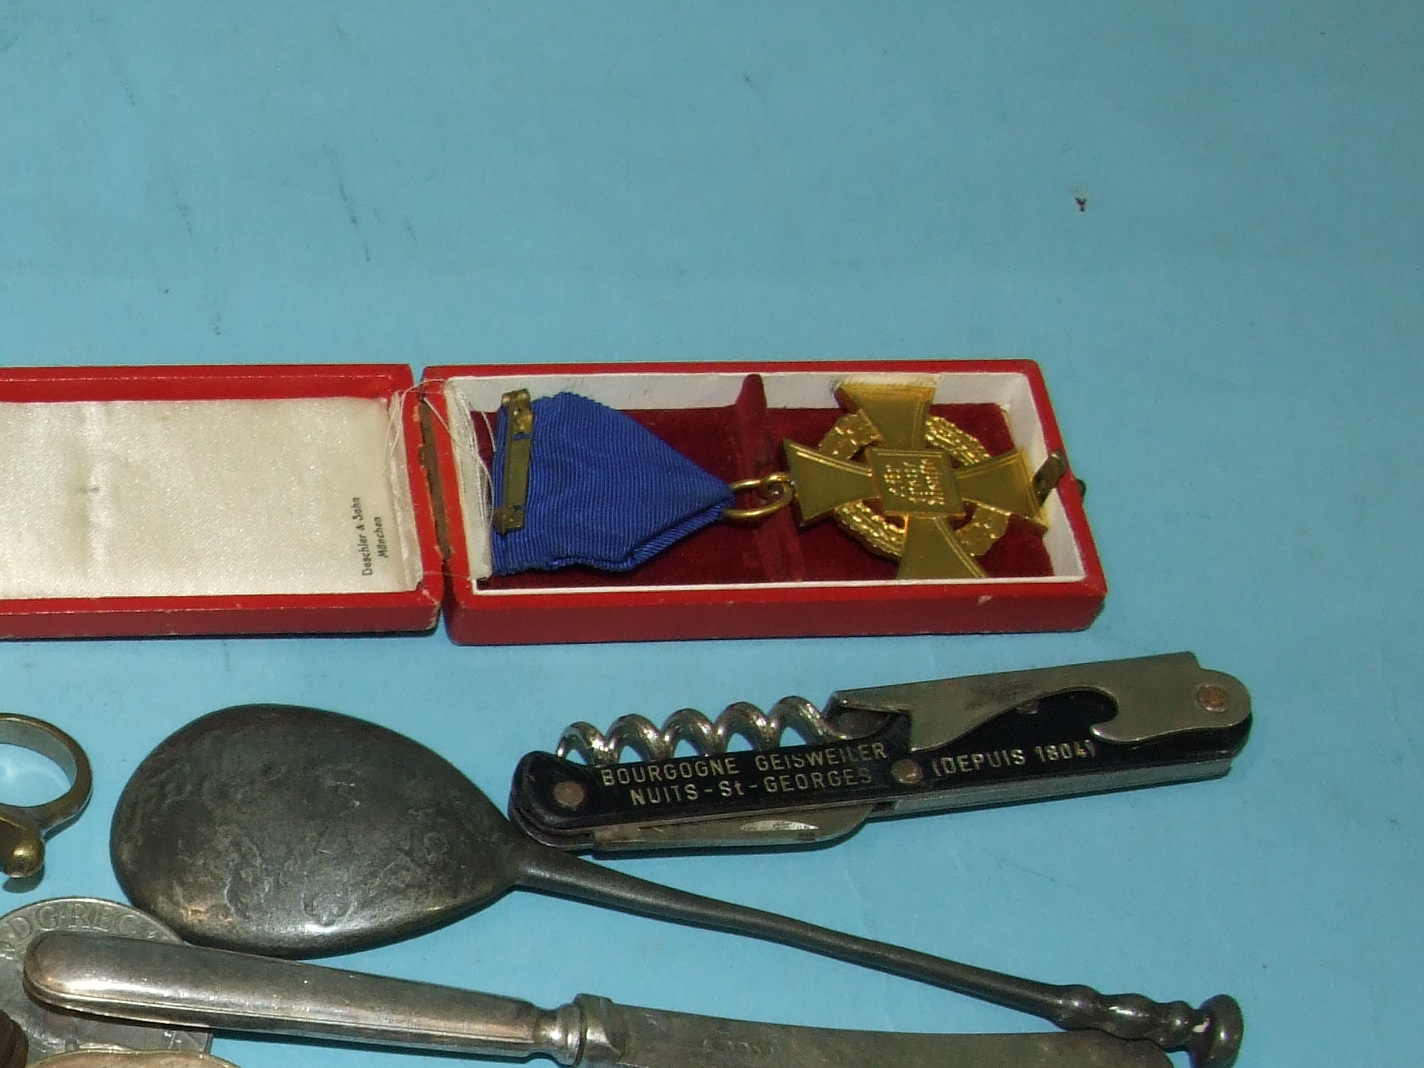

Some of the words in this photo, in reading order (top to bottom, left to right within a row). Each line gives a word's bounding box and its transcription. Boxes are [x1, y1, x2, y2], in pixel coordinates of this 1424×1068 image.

[351, 497, 364, 521] Sohn
[601, 757, 739, 787] BOURGOGNE
[755, 742, 888, 773] GEISWEILER
